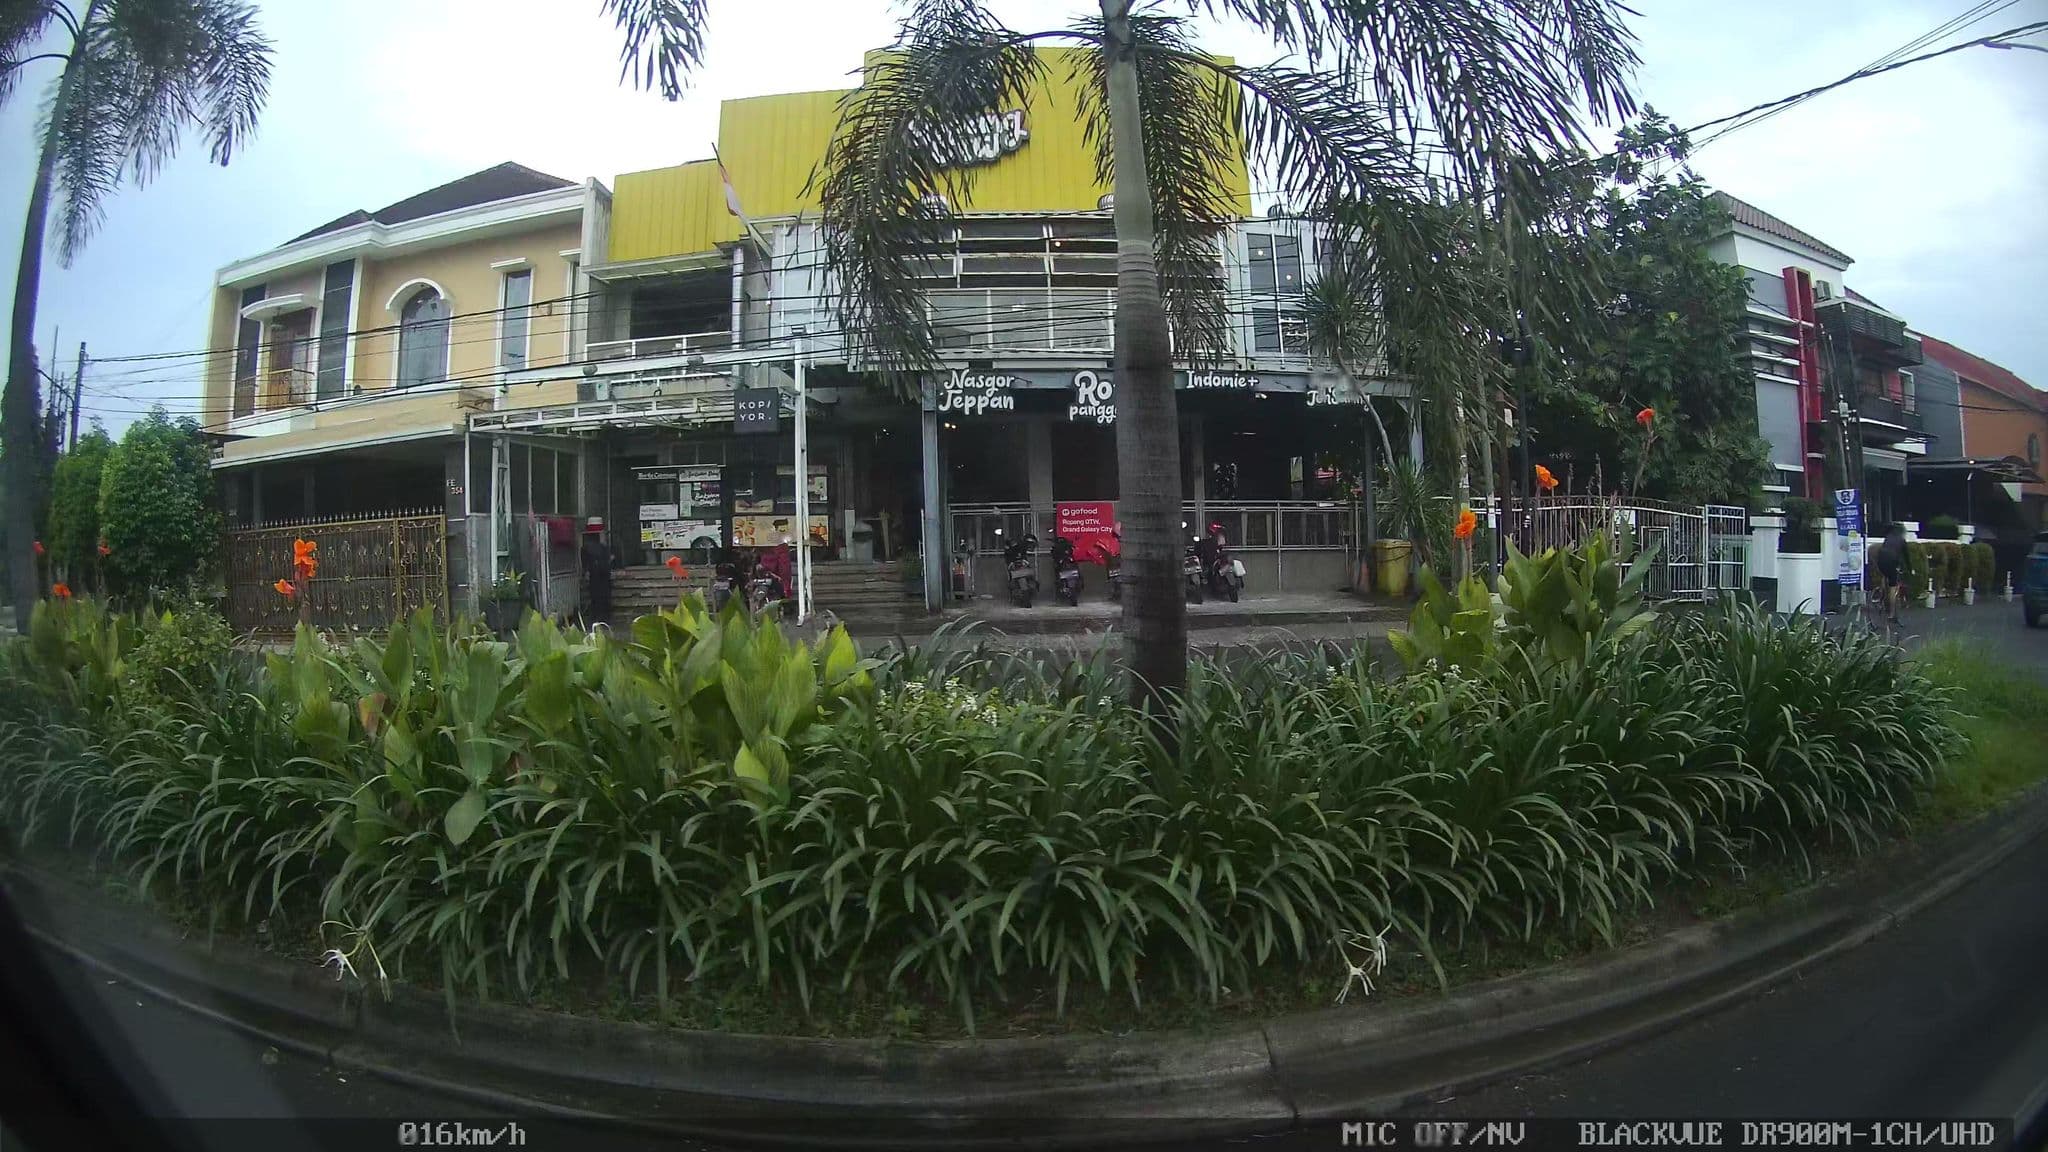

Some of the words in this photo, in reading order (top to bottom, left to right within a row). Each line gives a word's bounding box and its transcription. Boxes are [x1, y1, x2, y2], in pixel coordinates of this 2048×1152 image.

[944, 369, 1015, 396] Nasgor
[1074, 370, 1116, 406] Ro
[938, 389, 1014, 415] Teppan
[1070, 507, 1098, 516] gofood
[1081, 526, 1100, 534] Galaxy
